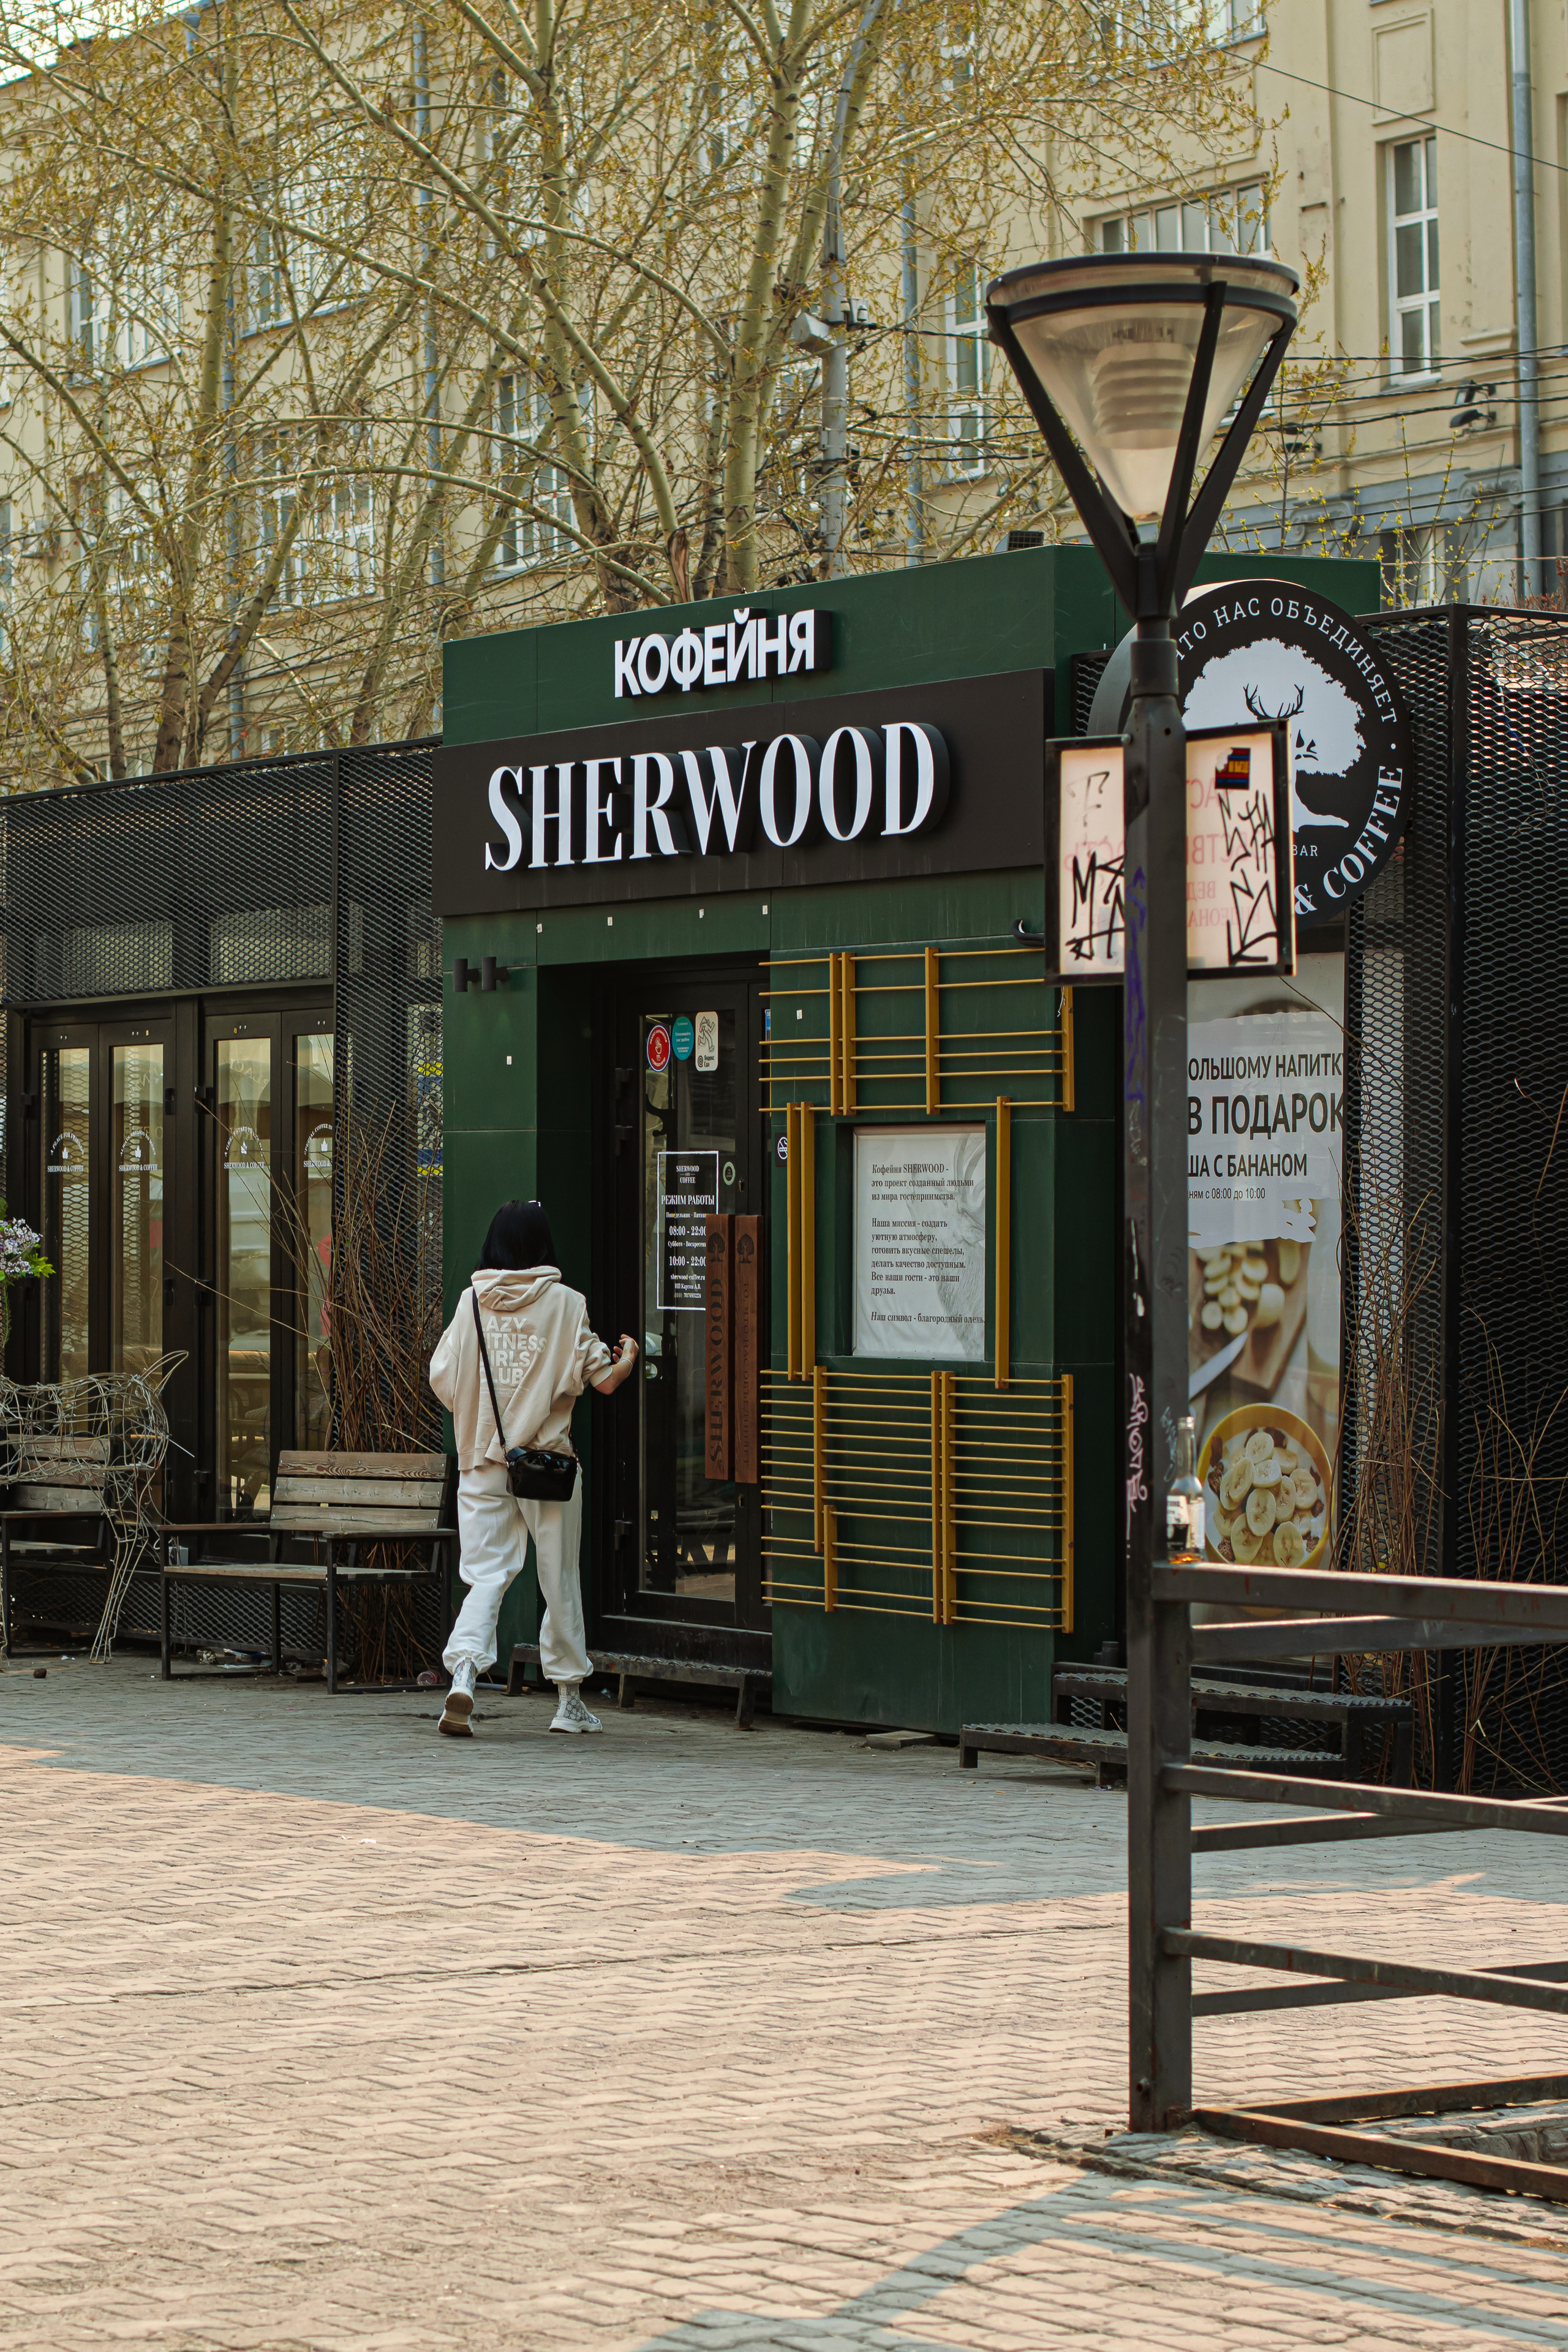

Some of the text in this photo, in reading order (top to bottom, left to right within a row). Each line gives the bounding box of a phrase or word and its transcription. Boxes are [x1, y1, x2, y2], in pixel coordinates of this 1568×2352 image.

[614, 608, 815, 698] КОФЕЙНЯ
[1213, 598, 1260, 627] НАС
[1271, 598, 1397, 723] ОБЪЕДИНЯЕТ
[484, 722, 935, 872] SHERWOOD
[1323, 766, 1403, 899] COFFEE
[1188, 1053, 1343, 1081] ОЛЬШОМУ НАПИТК
[1212, 1092, 1343, 1140] ПОДАРОК
[236, 1126, 247, 1135] START
[314, 1123, 328, 1133] COFFEE
[872, 1164, 902, 1175] Кофейня
[903, 1163, 944, 1174] SHERWOOD
[1188, 1153, 1307, 1177] ША С БАНАНОМ
[884, 1180, 907, 1189] проект
[908, 1177, 945, 1188] созданный
[662, 1194, 715, 1205] РЕЖИМ РАБОТЫ
[881, 1194, 898, 1202] мира
[899, 1193, 955, 1202] гостеприимства.
[1212, 1188, 1232, 1199] 08:00
[1233, 1191, 1243, 1200] до
[1246, 1188, 1265, 1199] 10:00
[872, 1218, 890, 1227] Наша
[669, 1226, 686, 1236] 08:00
[872, 1231, 937, 1243] уютную атмосферу,
[902, 1248, 930, 1256] вкусные
[669, 1256, 685, 1266] 10:00
[925, 1262, 966, 1270] доступным.
[872, 1271, 883, 1281] Все
[871, 1287, 895, 1296] друзья.
[483, 1315, 527, 1333] AZY
[871, 1311, 886, 1321] Наш
[918, 1313, 963, 1325] благородный
[484, 1332, 548, 1353] ITNESS
[710, 1278, 723, 1463] SHERWOOD
